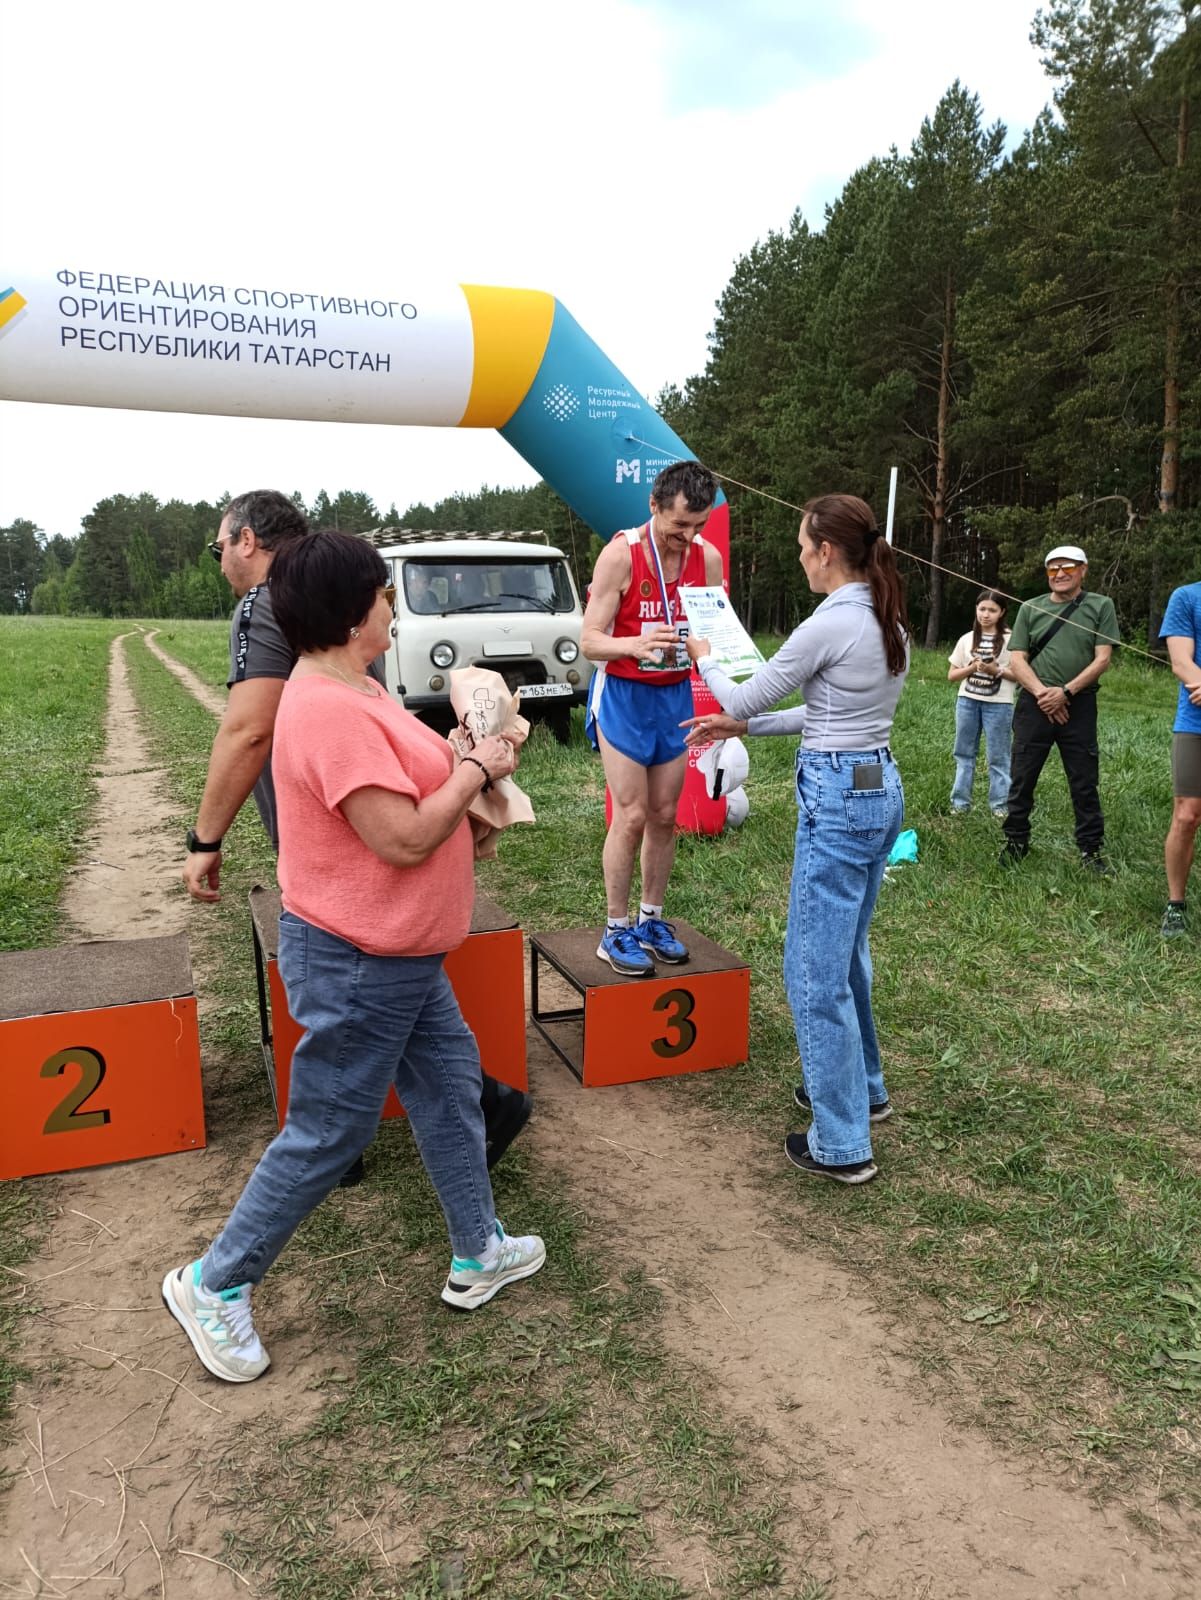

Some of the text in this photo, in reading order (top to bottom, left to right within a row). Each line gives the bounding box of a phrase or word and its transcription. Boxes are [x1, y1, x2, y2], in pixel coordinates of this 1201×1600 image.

[56, 269, 418, 320] ФЕДЕРАЦИЯ СПОРТИВНОГО
[58, 295, 317, 339] ОРИЕНТИРОВАНИЯ
[60, 326, 391, 373] РЕСПУБЛИКИ ТАТАРСТАН
[588, 409, 617, 420] Центр
[645, 459, 679, 467] МИНИСТ
[651, 988, 697, 1059] 3
[40, 1046, 111, 1135] 2
